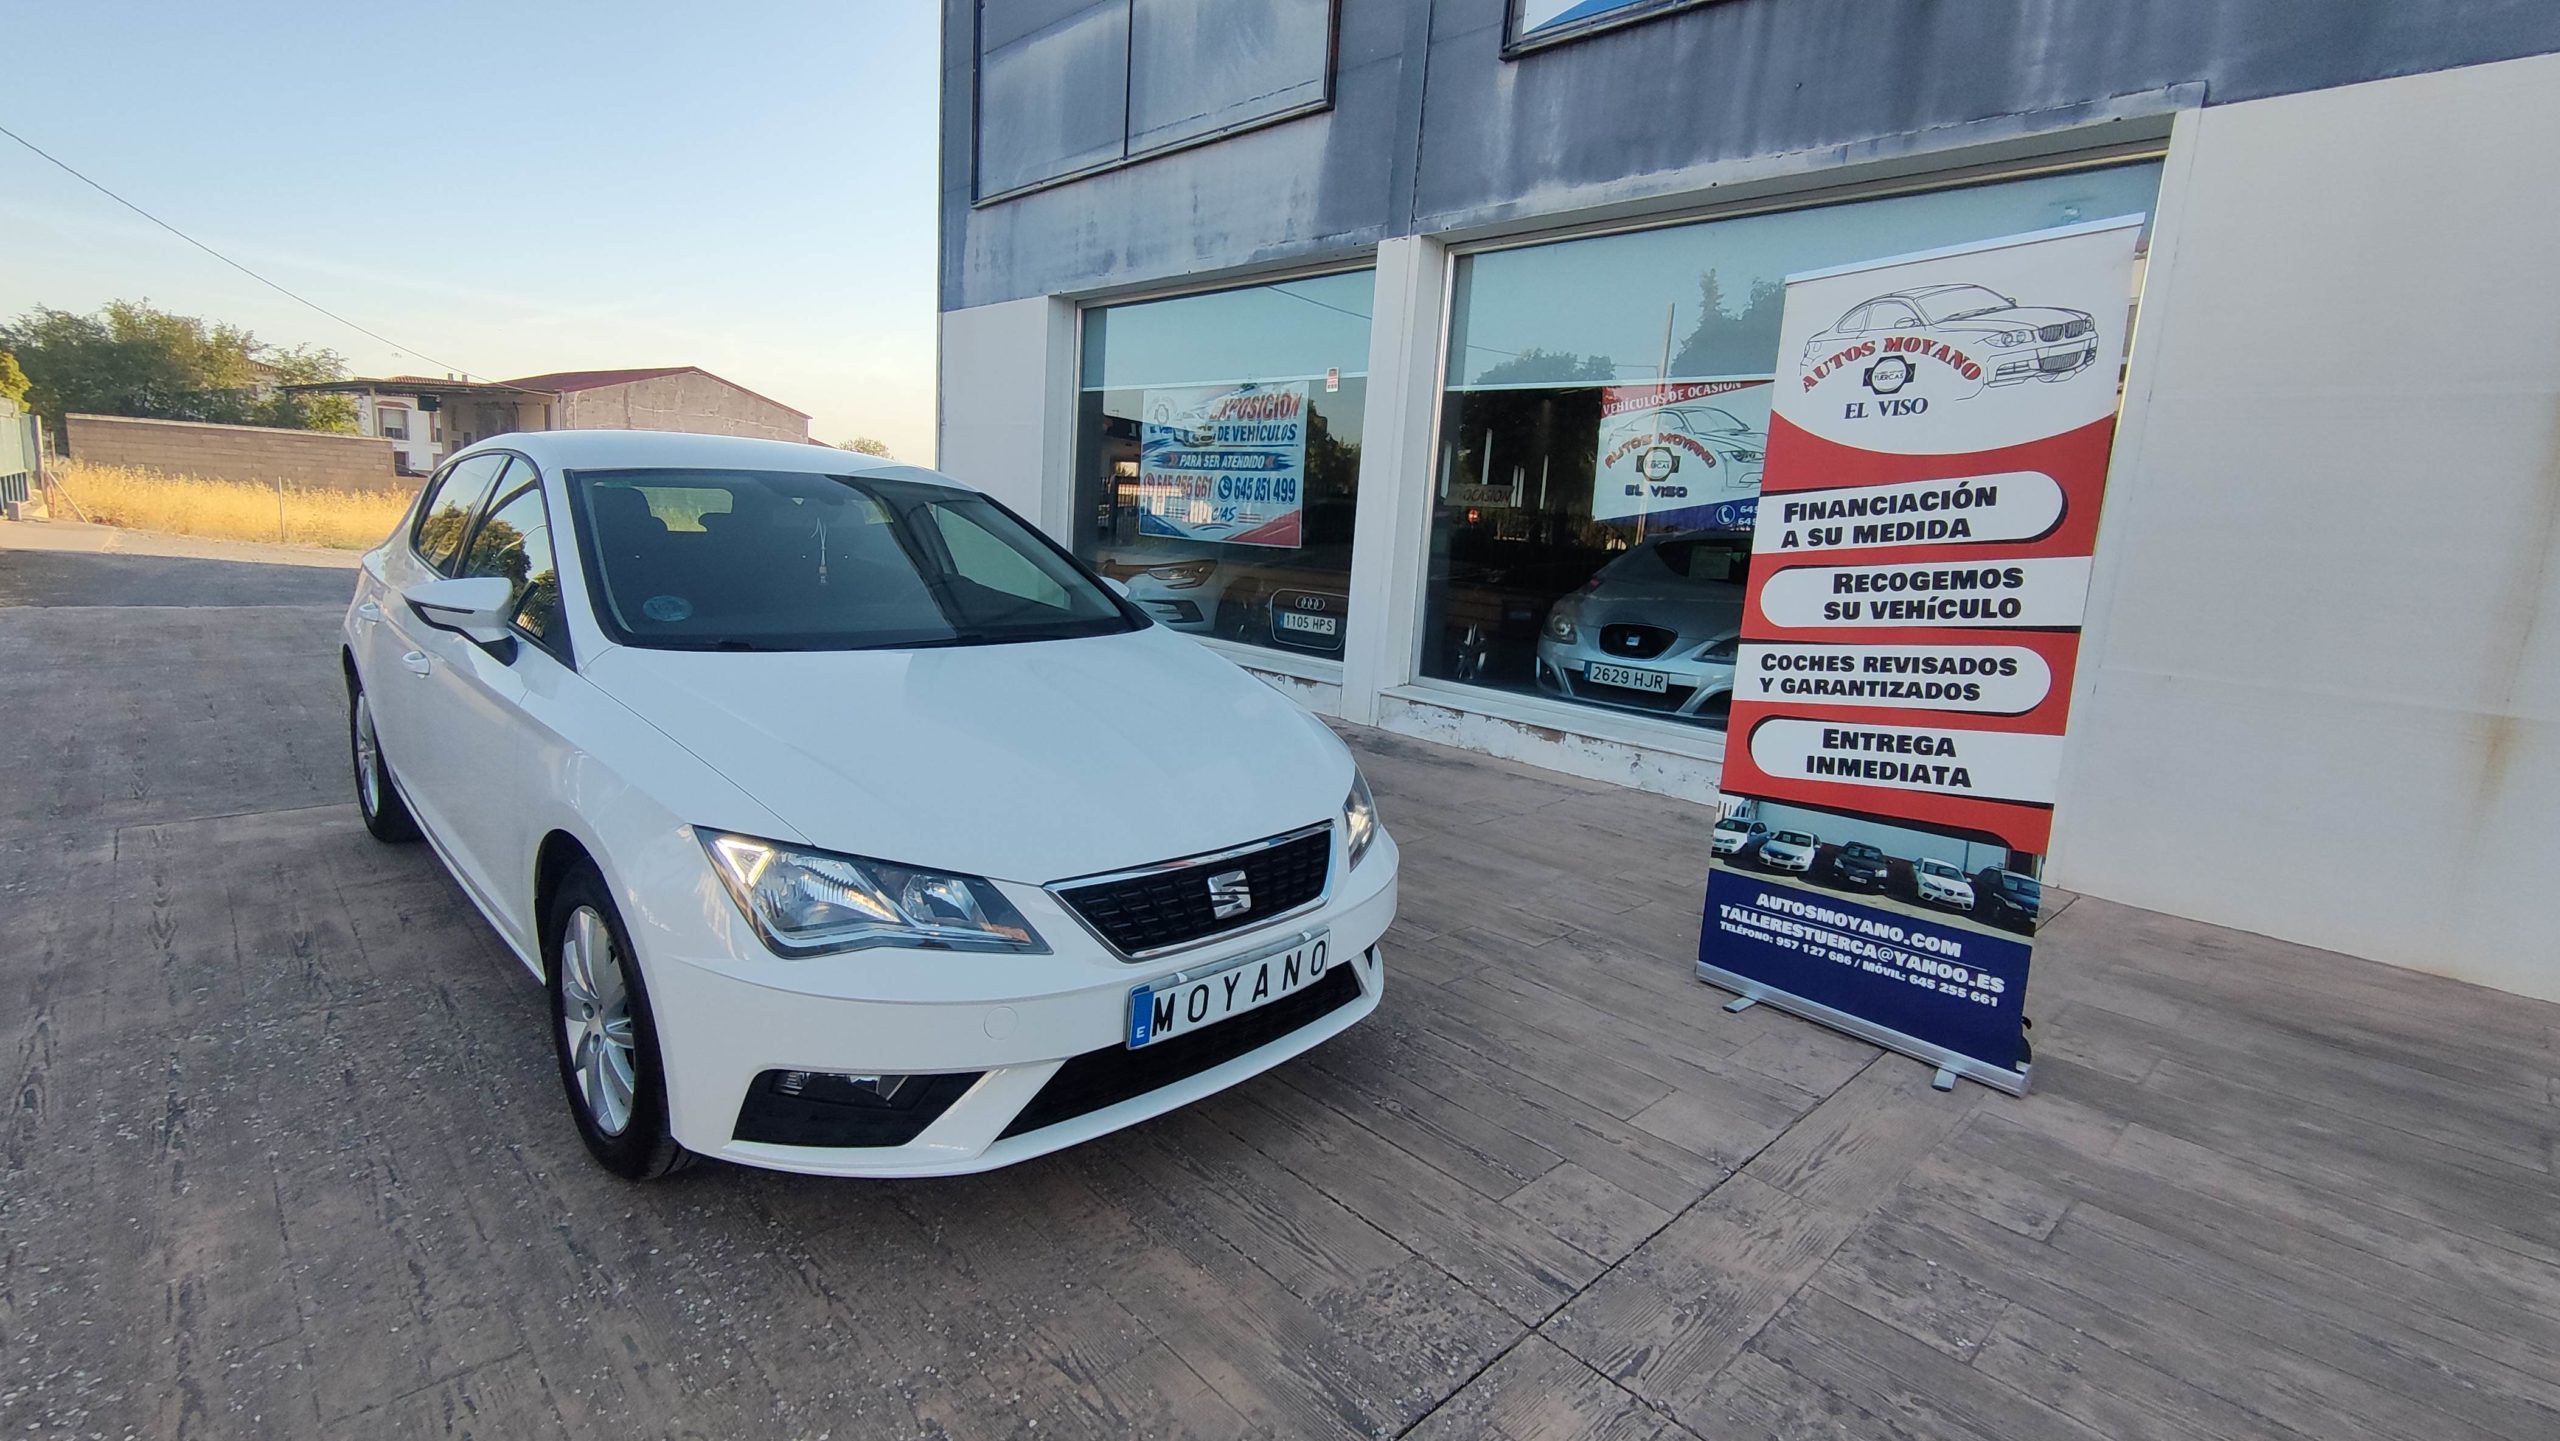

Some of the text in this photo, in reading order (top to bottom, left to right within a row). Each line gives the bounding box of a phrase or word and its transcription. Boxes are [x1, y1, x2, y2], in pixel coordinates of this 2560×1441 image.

[1803, 337, 1982, 392] AUTOS MOYANO
[1668, 389, 1684, 402] DE
[1844, 398, 1929, 420] EL VISO
[1217, 420, 1298, 442] DE VEHÍCULOS
[1179, 454, 1265, 469] PARA SER ATENDIDO
[1605, 432, 1717, 469] AUTOS MOYANO
[1194, 475, 1213, 499] 661
[1234, 476, 1296, 502] 645 851 499
[1625, 484, 1688, 498] EL VISO
[1783, 481, 1998, 523] FINANCIACIÓN
[1781, 518, 1971, 548] A SU MEDIDA
[1833, 567, 2024, 594] RECOGEMOS
[1286, 614, 1333, 632] 1105 HPS
[1824, 601, 1861, 620] SU
[1761, 653, 2018, 676] COCHES REVISADOS
[1593, 666, 1663, 690] 2629 HJR
[1759, 677, 1981, 701] Y GARANTIZADOS
[1822, 728, 1957, 757] ENTREGA
[1806, 755, 1972, 788] INMEDIATA
[1756, 892, 1962, 958] AUTOSMOYANO.COM
[1719, 904, 2005, 993] TALLERESTUERCA@YAHOO.ES
[1719, 920, 1774, 944] TELÉFONO:
[1776, 936, 1799, 950] 957
[1802, 943, 1826, 957] 127
[1828, 950, 1852, 966] 686
[1909, 974, 1936, 990] 645
[1939, 982, 1967, 998] 255
[1970, 991, 1999, 1007] 661
[1135, 940, 1327, 1039] E MOYANO
